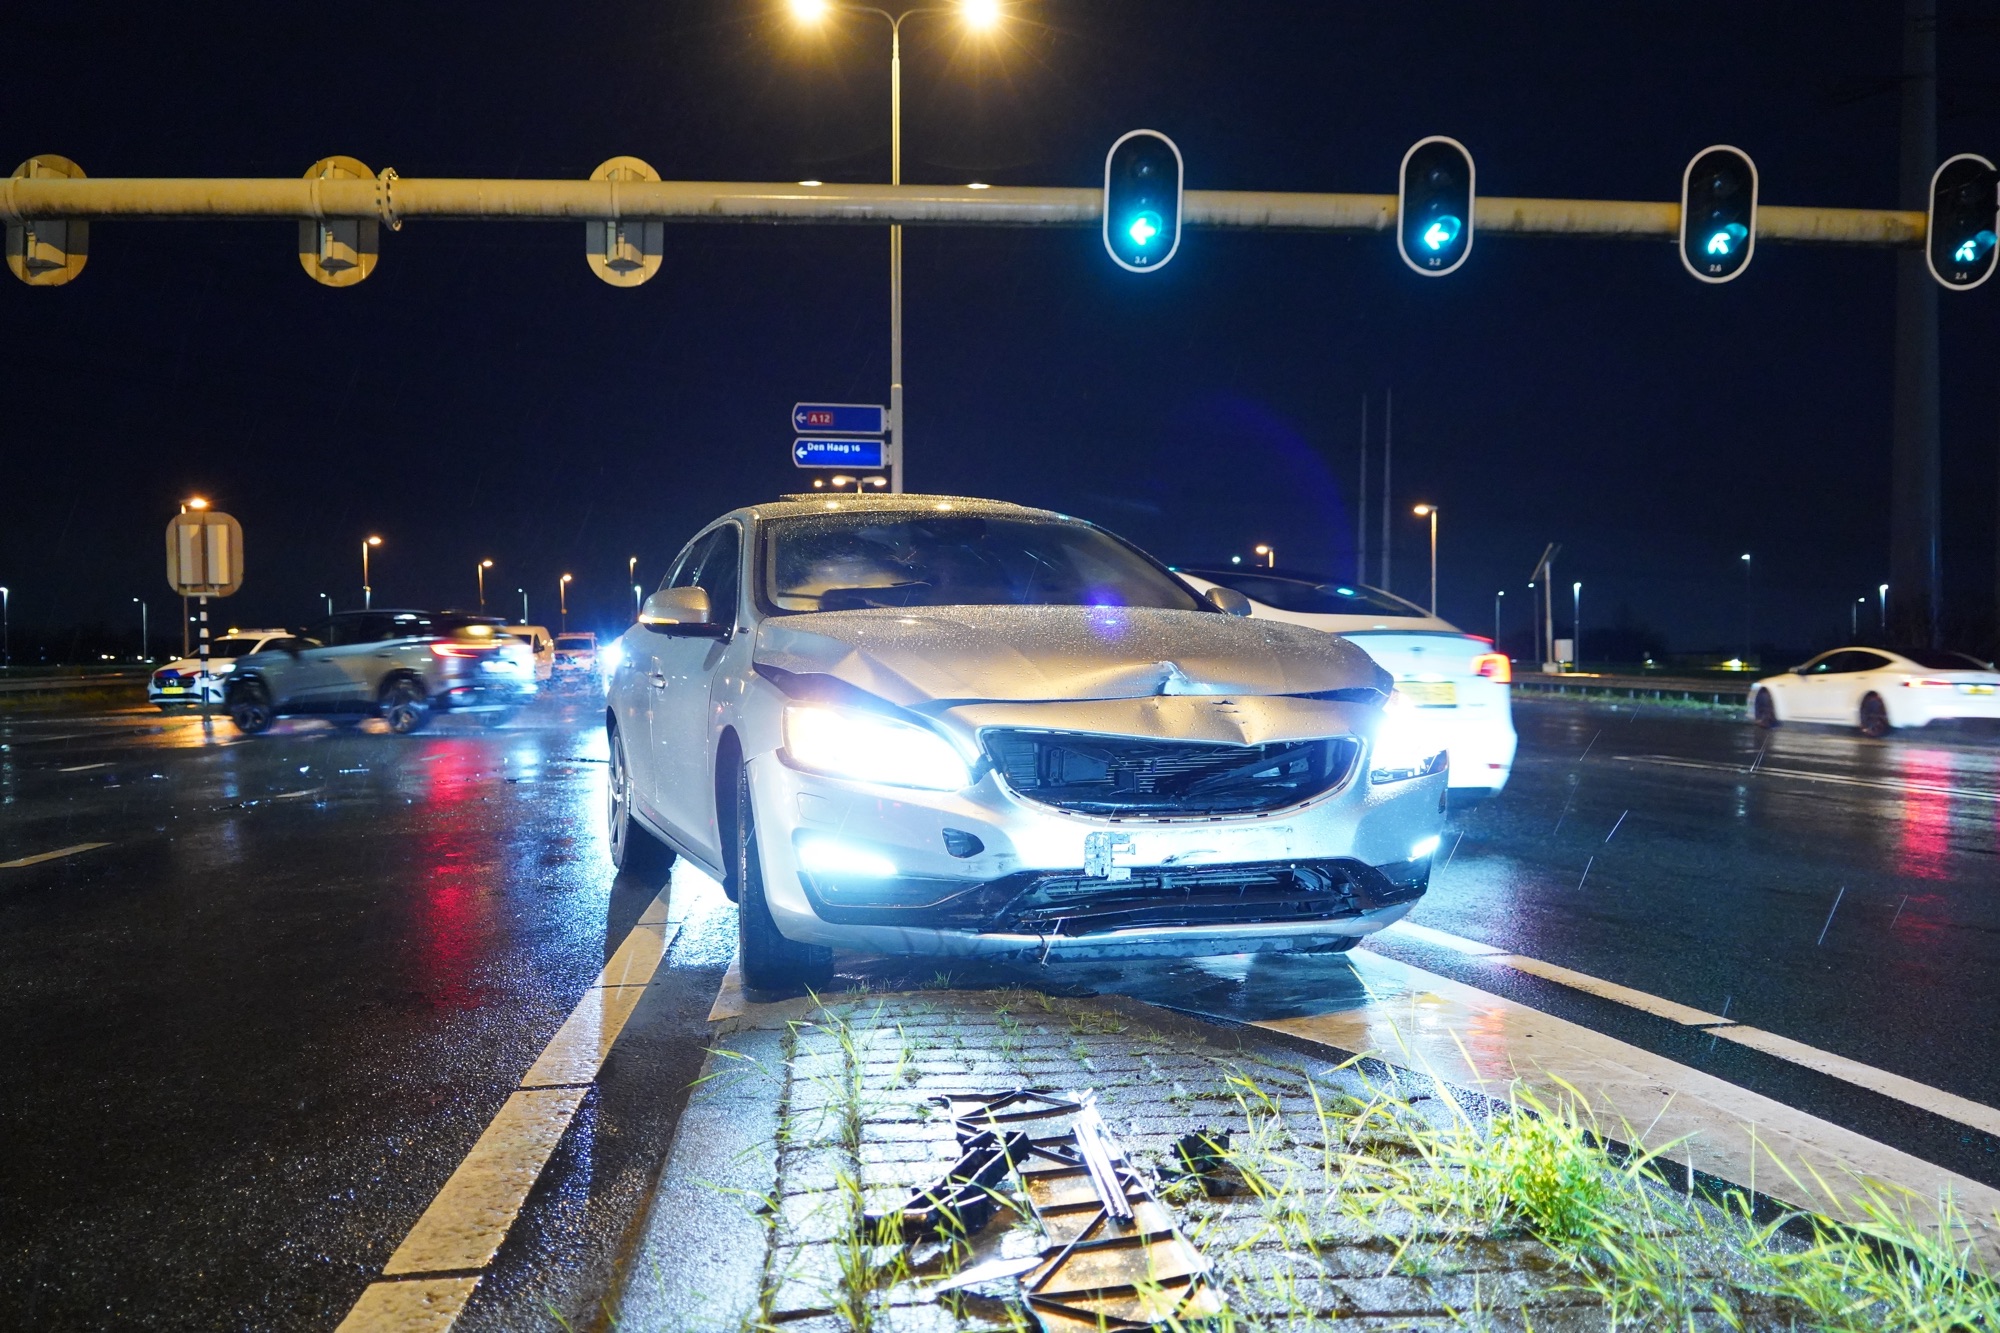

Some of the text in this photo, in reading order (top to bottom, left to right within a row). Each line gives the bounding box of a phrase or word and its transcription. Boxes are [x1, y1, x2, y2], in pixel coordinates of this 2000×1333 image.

[1955, 272, 1967, 280] 2.4
[807, 443, 861, 453] Den Haag 16
